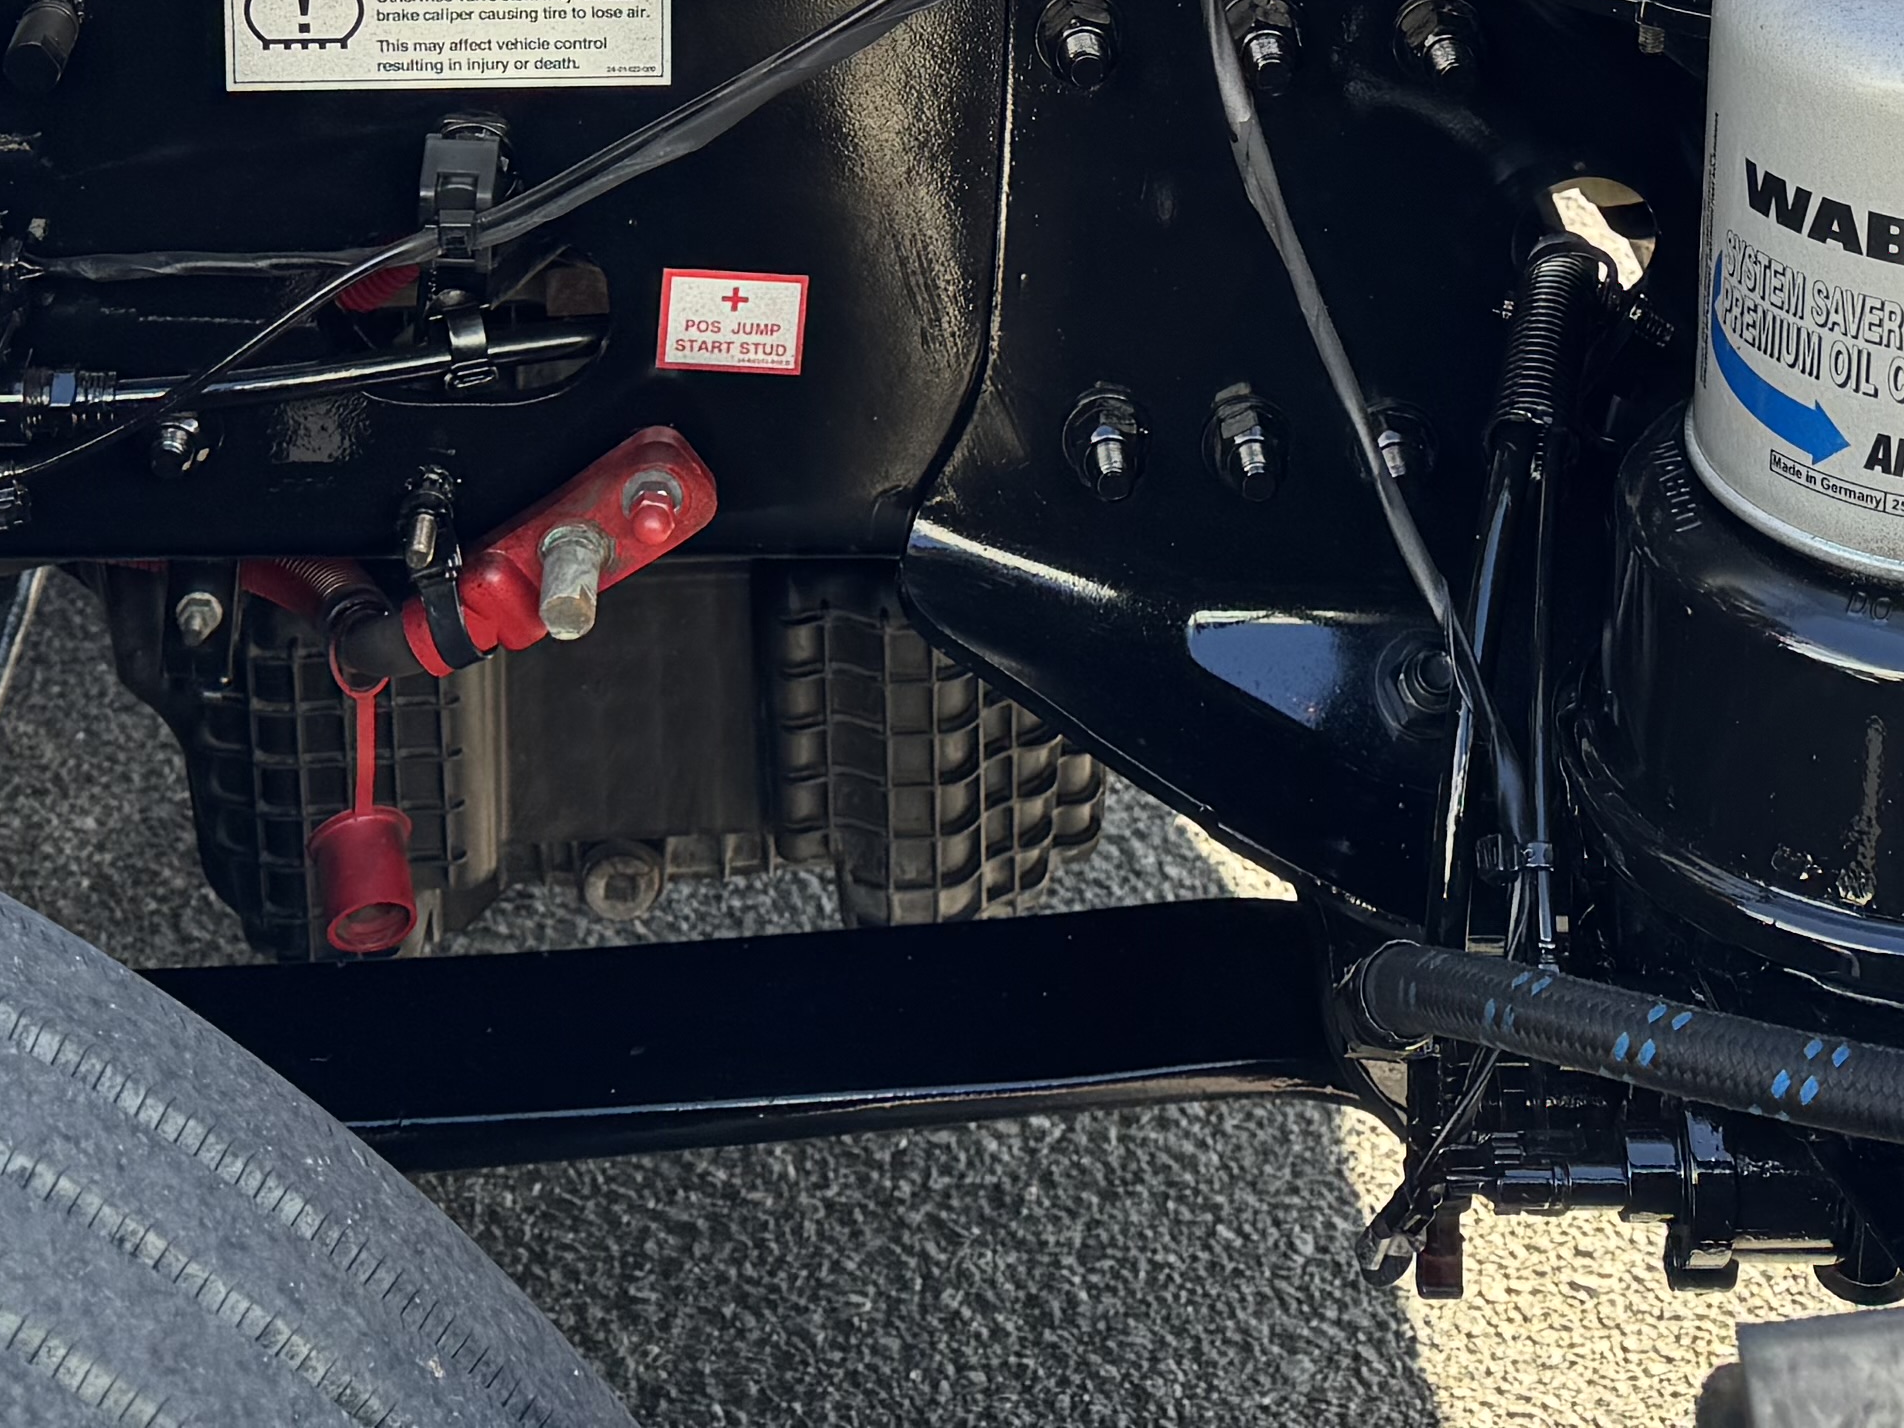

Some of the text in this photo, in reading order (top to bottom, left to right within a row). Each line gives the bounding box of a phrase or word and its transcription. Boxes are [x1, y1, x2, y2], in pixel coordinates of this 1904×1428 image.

[376, 6, 650, 23] brake caliper causing tire to lose air.
[377, 37, 607, 55] This may affect vehicle control
[377, 57, 580, 75] resulting in injury or death.
[1725, 230, 1806, 320] SYSTEM
[1810, 278, 1904, 352] SAVER
[685, 320, 782, 336] POS JUMP
[1720, 277, 1823, 382] PREMIUM
[1829, 340, 1879, 399] OIL
[674, 339, 787, 357] START STUD
[1772, 455, 1883, 510] Made in Germany
